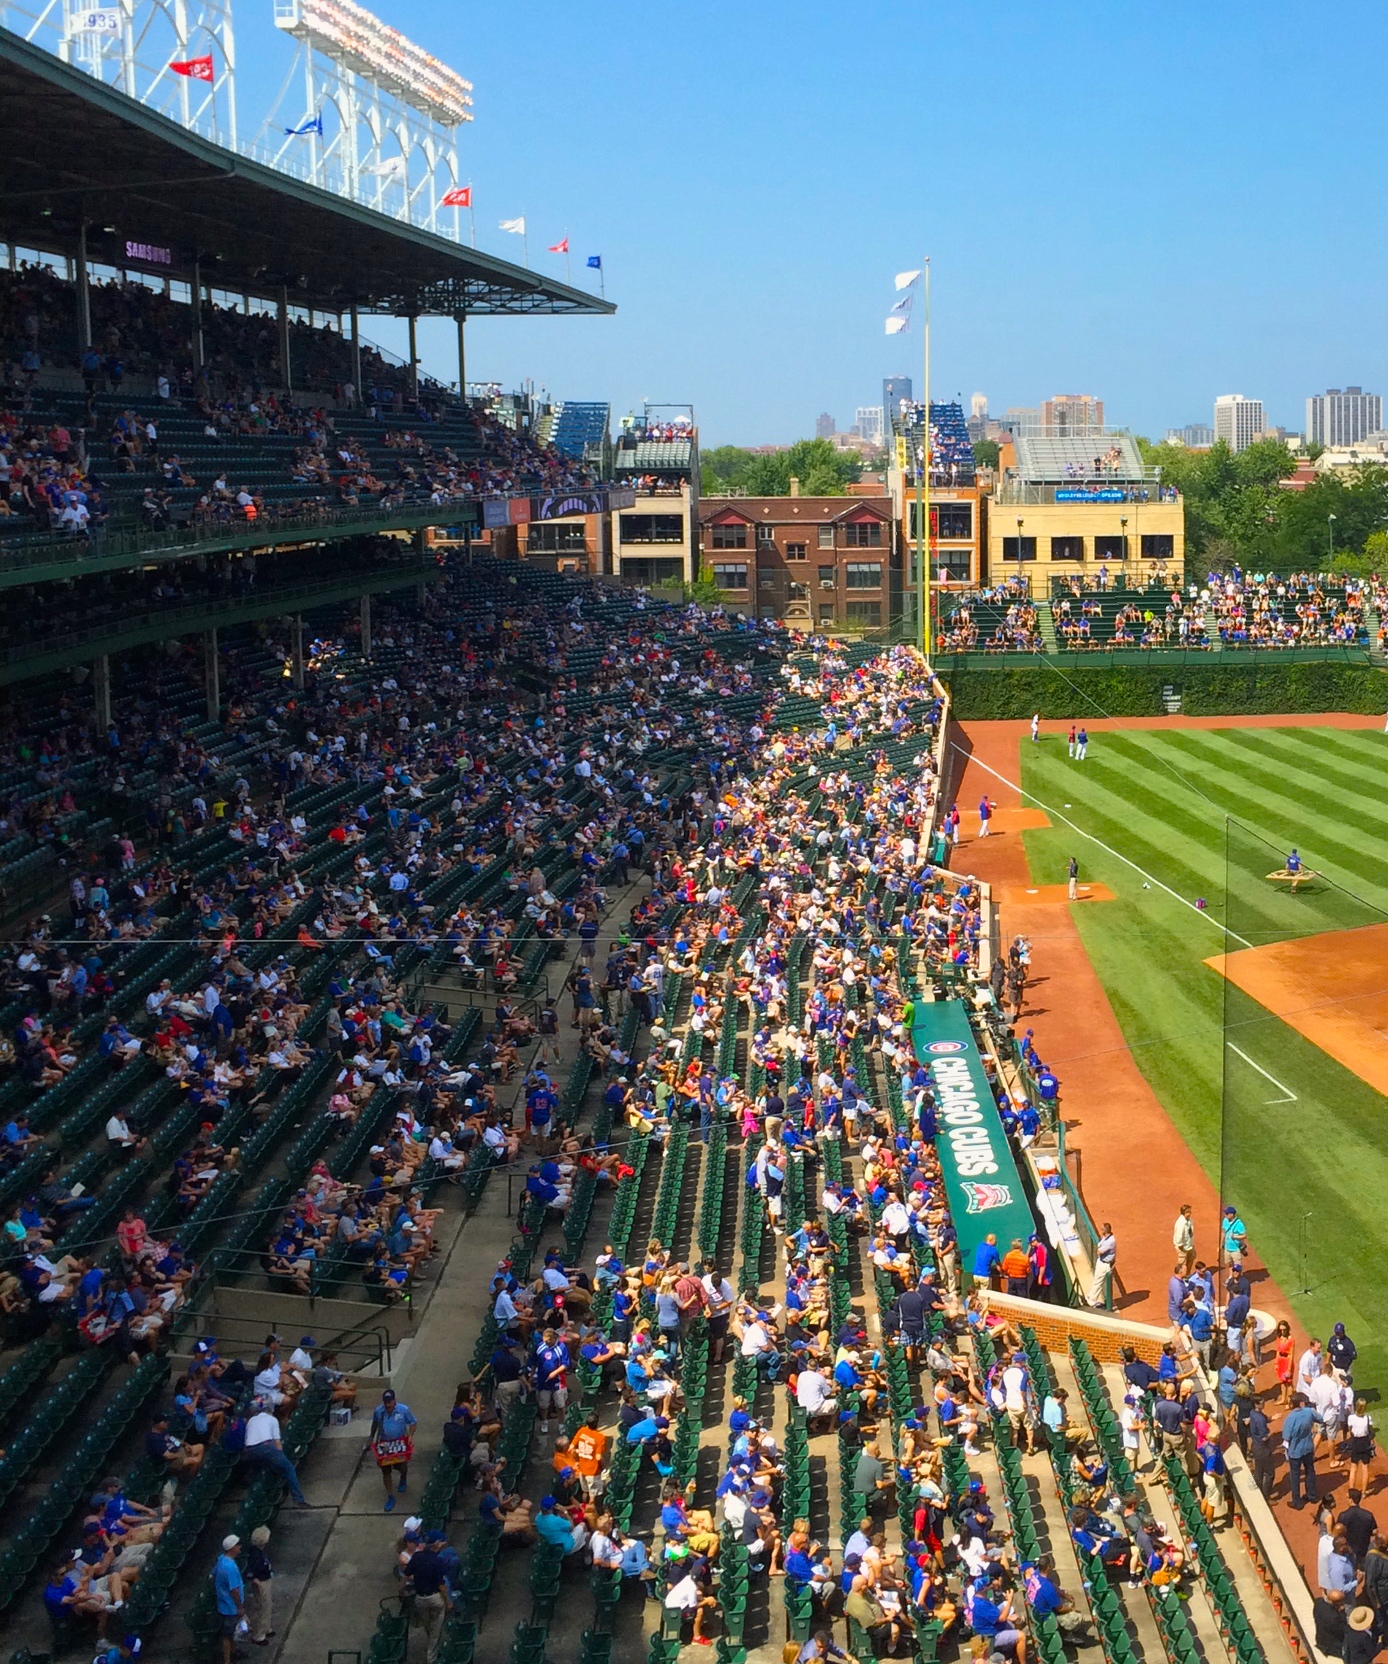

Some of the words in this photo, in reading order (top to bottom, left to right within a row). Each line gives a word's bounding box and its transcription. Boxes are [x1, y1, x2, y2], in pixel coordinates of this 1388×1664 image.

[126, 241, 171, 264] SAMSUNG
[930, 1056, 984, 1126] CHICAGO
[948, 1126, 999, 1177] CUBS
